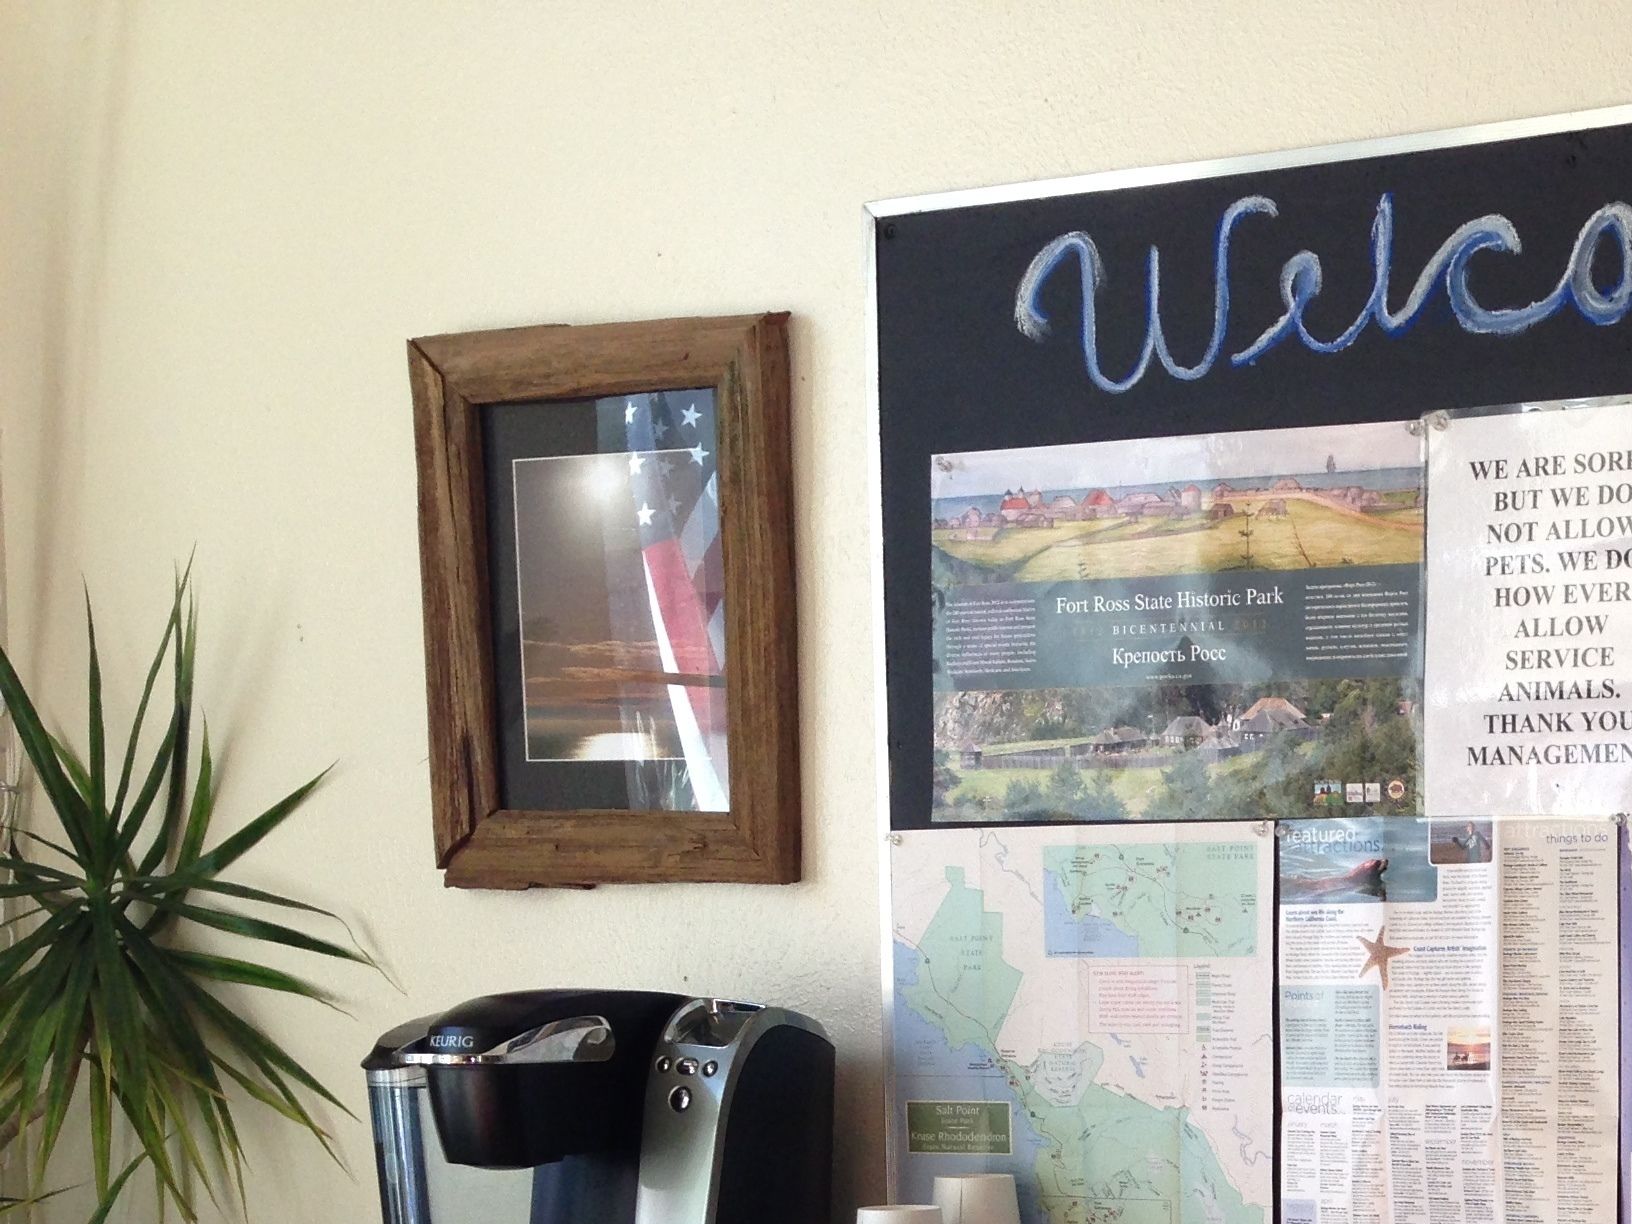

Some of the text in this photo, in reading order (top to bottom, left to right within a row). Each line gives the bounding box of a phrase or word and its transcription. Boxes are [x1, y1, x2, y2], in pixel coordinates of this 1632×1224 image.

[1469, 460, 1508, 481] WE
[1516, 455, 1566, 479] ARE
[1494, 489, 1542, 511] BUT
[1550, 486, 1590, 508] WE
[1487, 522, 1538, 544] NOT
[1484, 554, 1551, 576] PETS.
[1558, 550, 1598, 572] WE
[1056, 585, 1285, 615] Fort Ross State Historic Park
[1494, 581, 1632, 608] HOW EVER
[1112, 620, 1226, 636] BICENTENNIAL
[1514, 615, 1609, 639] ALLOW
[1112, 643, 1227, 669] Крепость Росс
[1505, 647, 1615, 670] SERVICE
[1498, 679, 1621, 702] ANIMALS.
[1483, 713, 1574, 734] THANK
[1546, 833, 1609, 845] things to do
[429, 1034, 475, 1050] KEURIG
[936, 1104, 980, 1115] Salt Point
[1286, 1092, 1343, 1106] calendar
